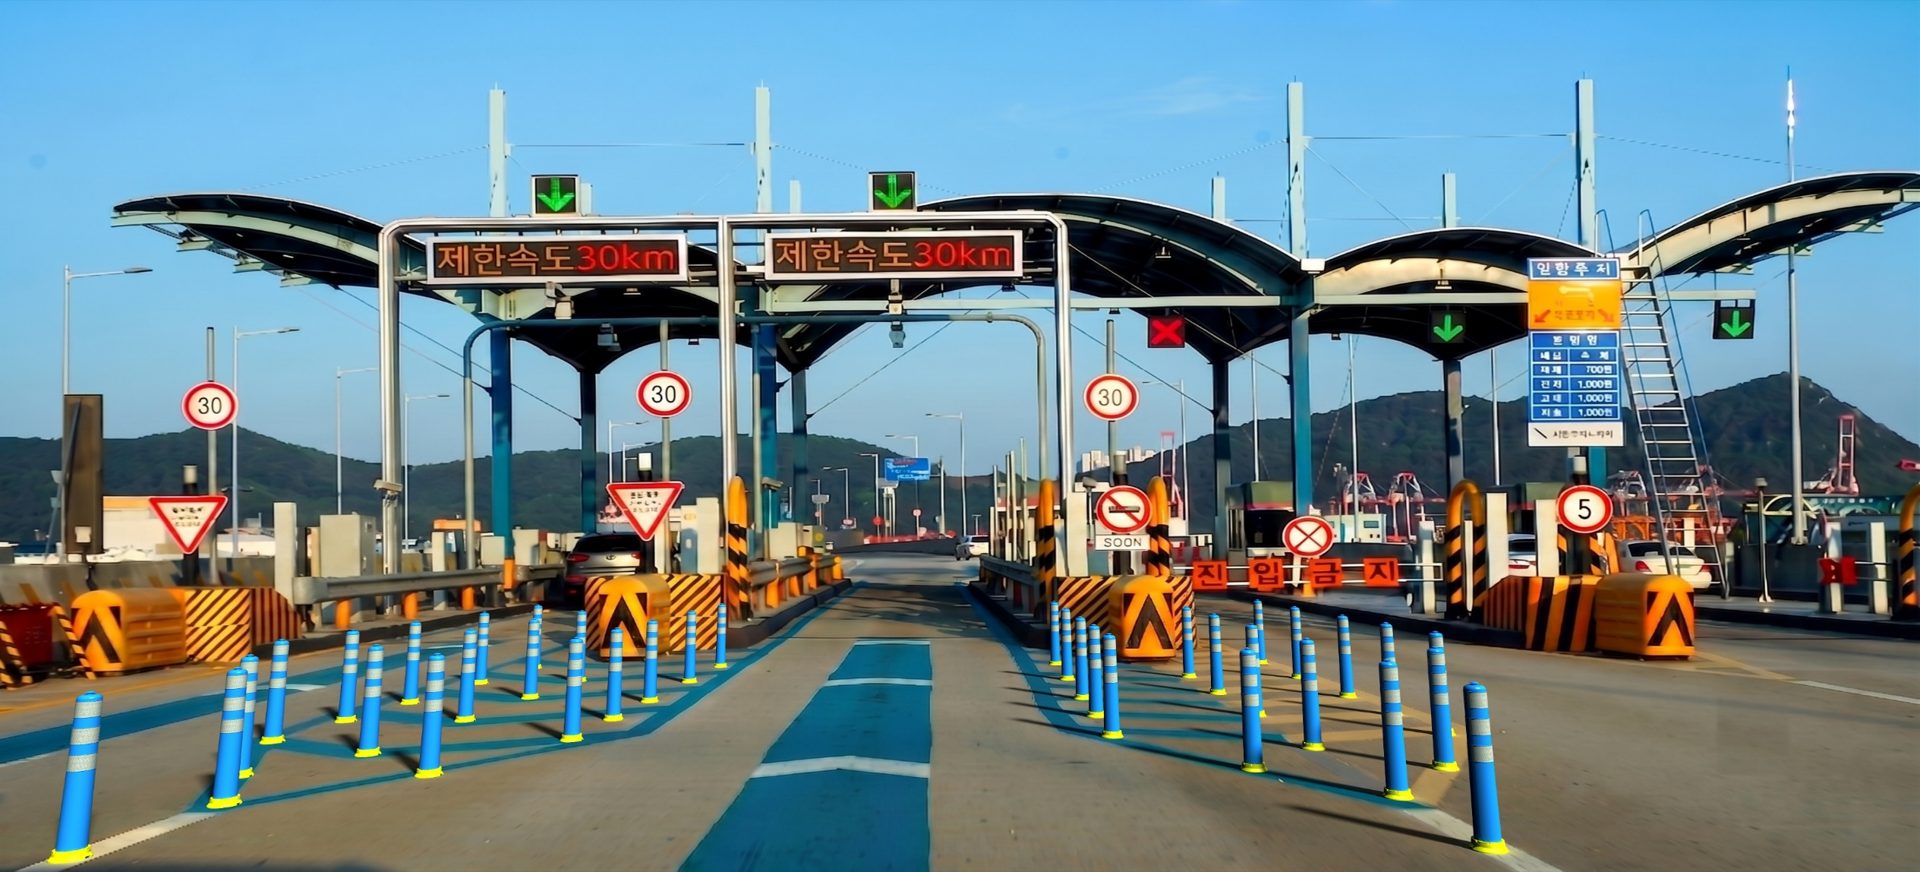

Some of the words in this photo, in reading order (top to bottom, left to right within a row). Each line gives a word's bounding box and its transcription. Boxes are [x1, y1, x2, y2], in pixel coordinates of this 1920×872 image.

[652, 385, 677, 403] 30
[1098, 388, 1123, 406] 30
[198, 397, 222, 414] 30
[1578, 499, 1592, 520] 5
[1103, 537, 1143, 548] SOON
